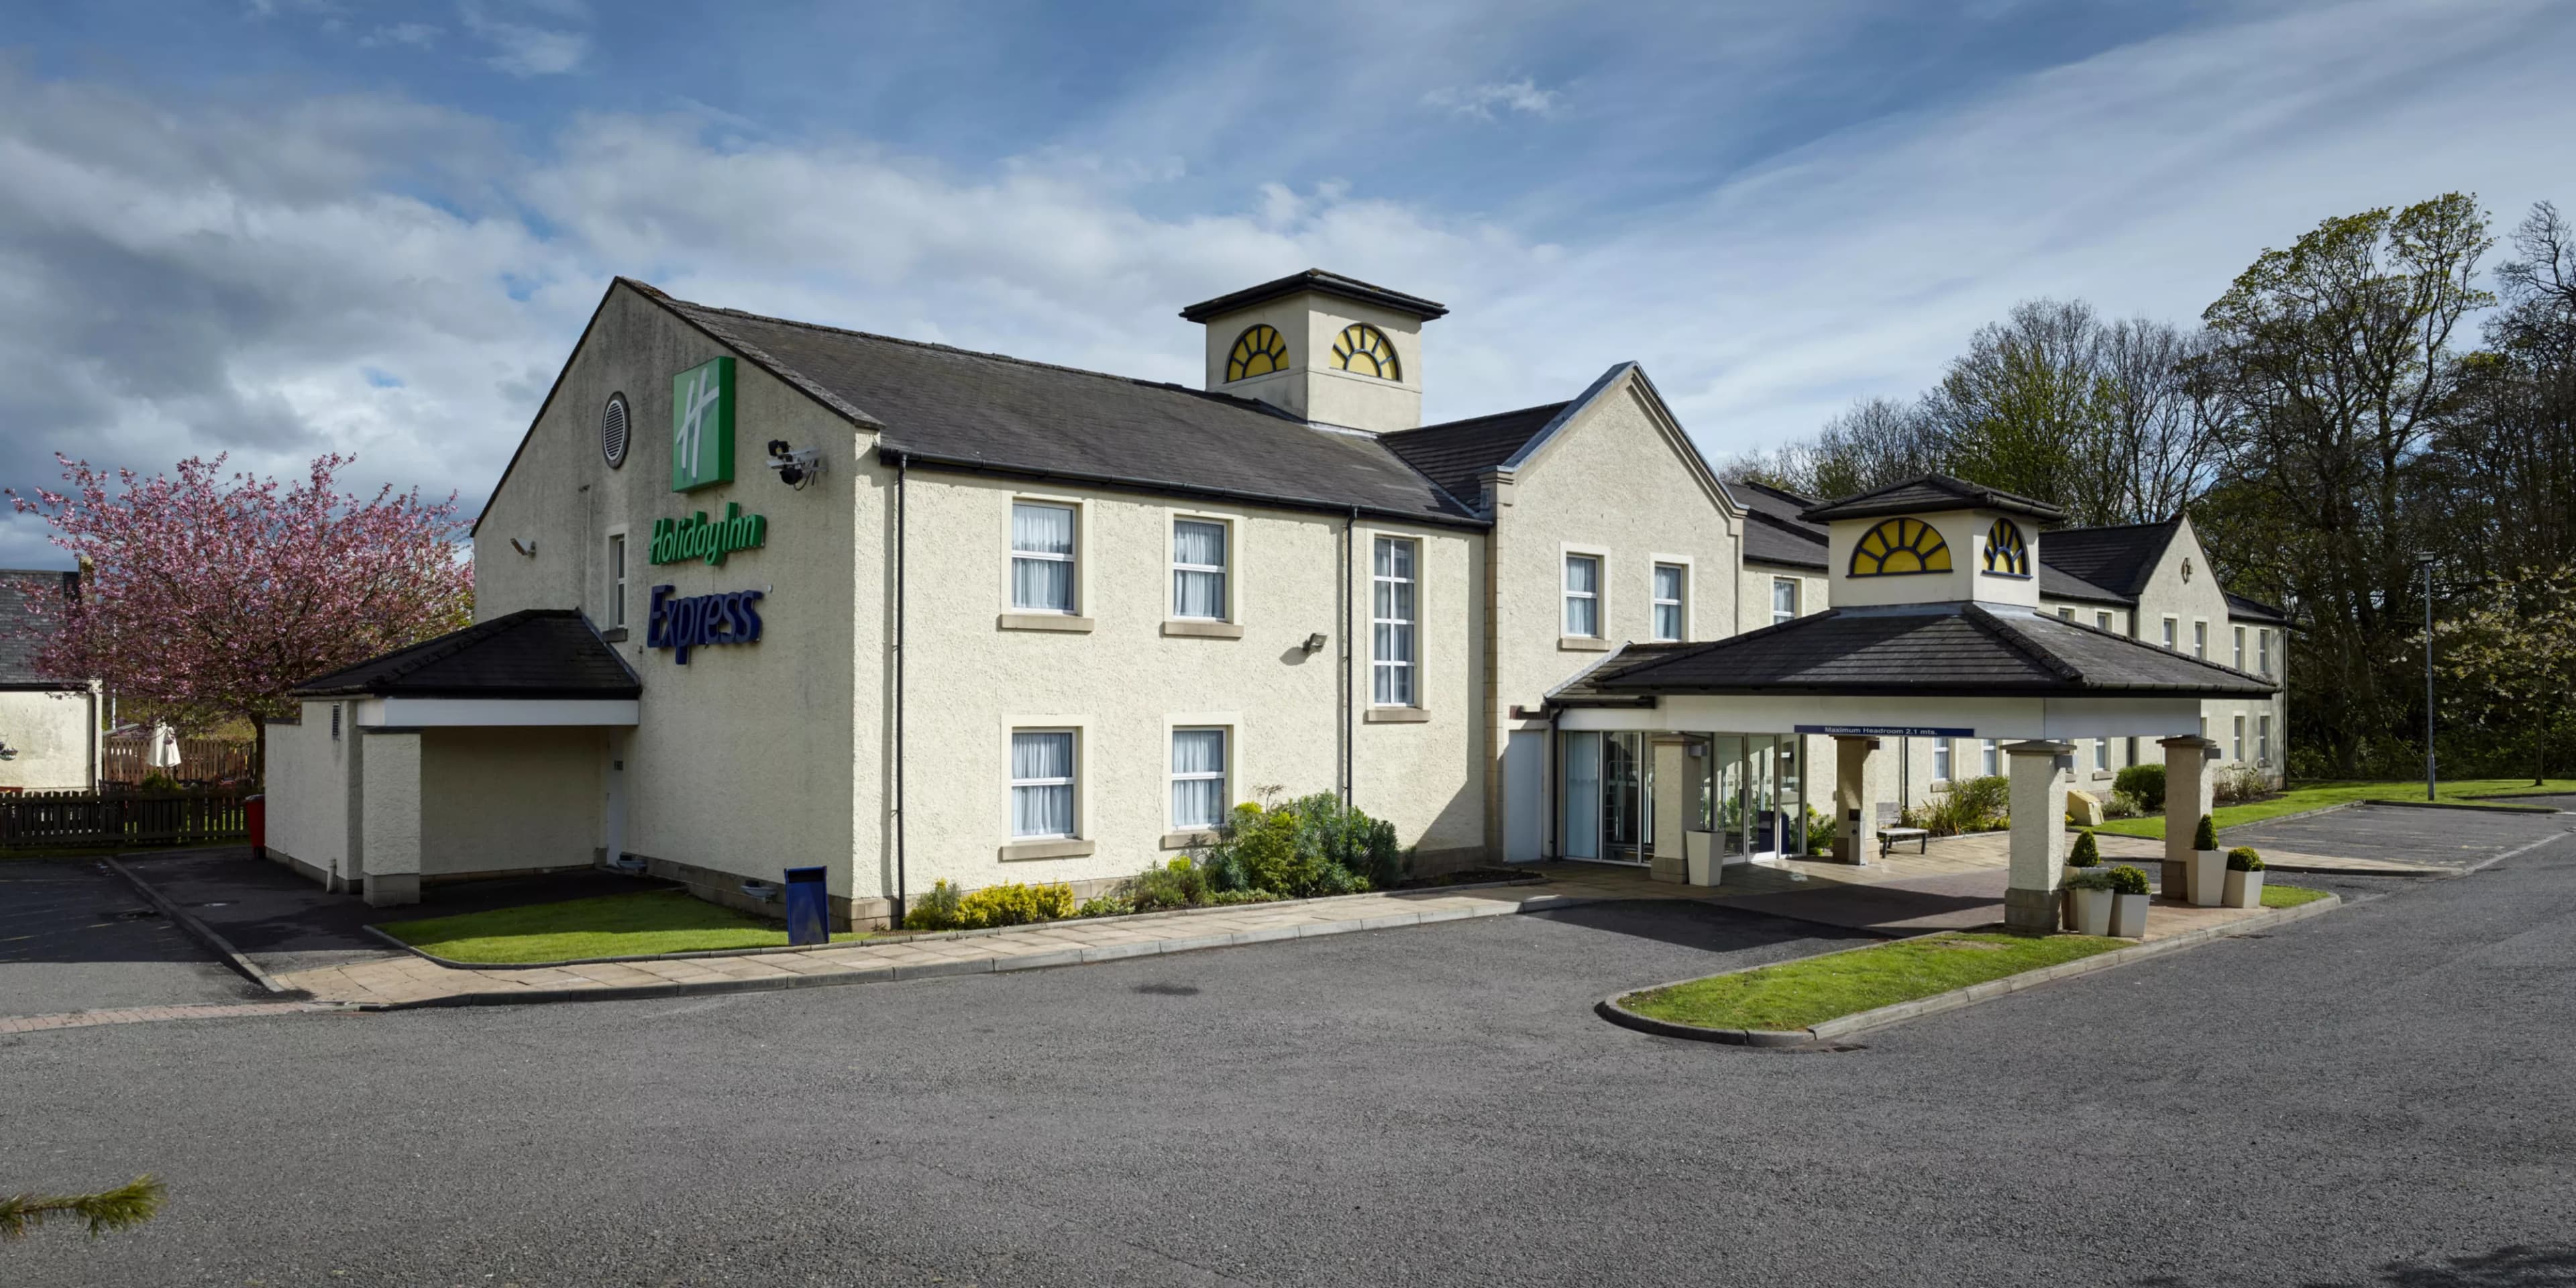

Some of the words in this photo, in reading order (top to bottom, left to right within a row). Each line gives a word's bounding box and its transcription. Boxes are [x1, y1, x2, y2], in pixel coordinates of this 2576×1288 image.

[649, 511, 724, 566] Holiday
[722, 502, 763, 552] Inn
[647, 585, 762, 664] Express
